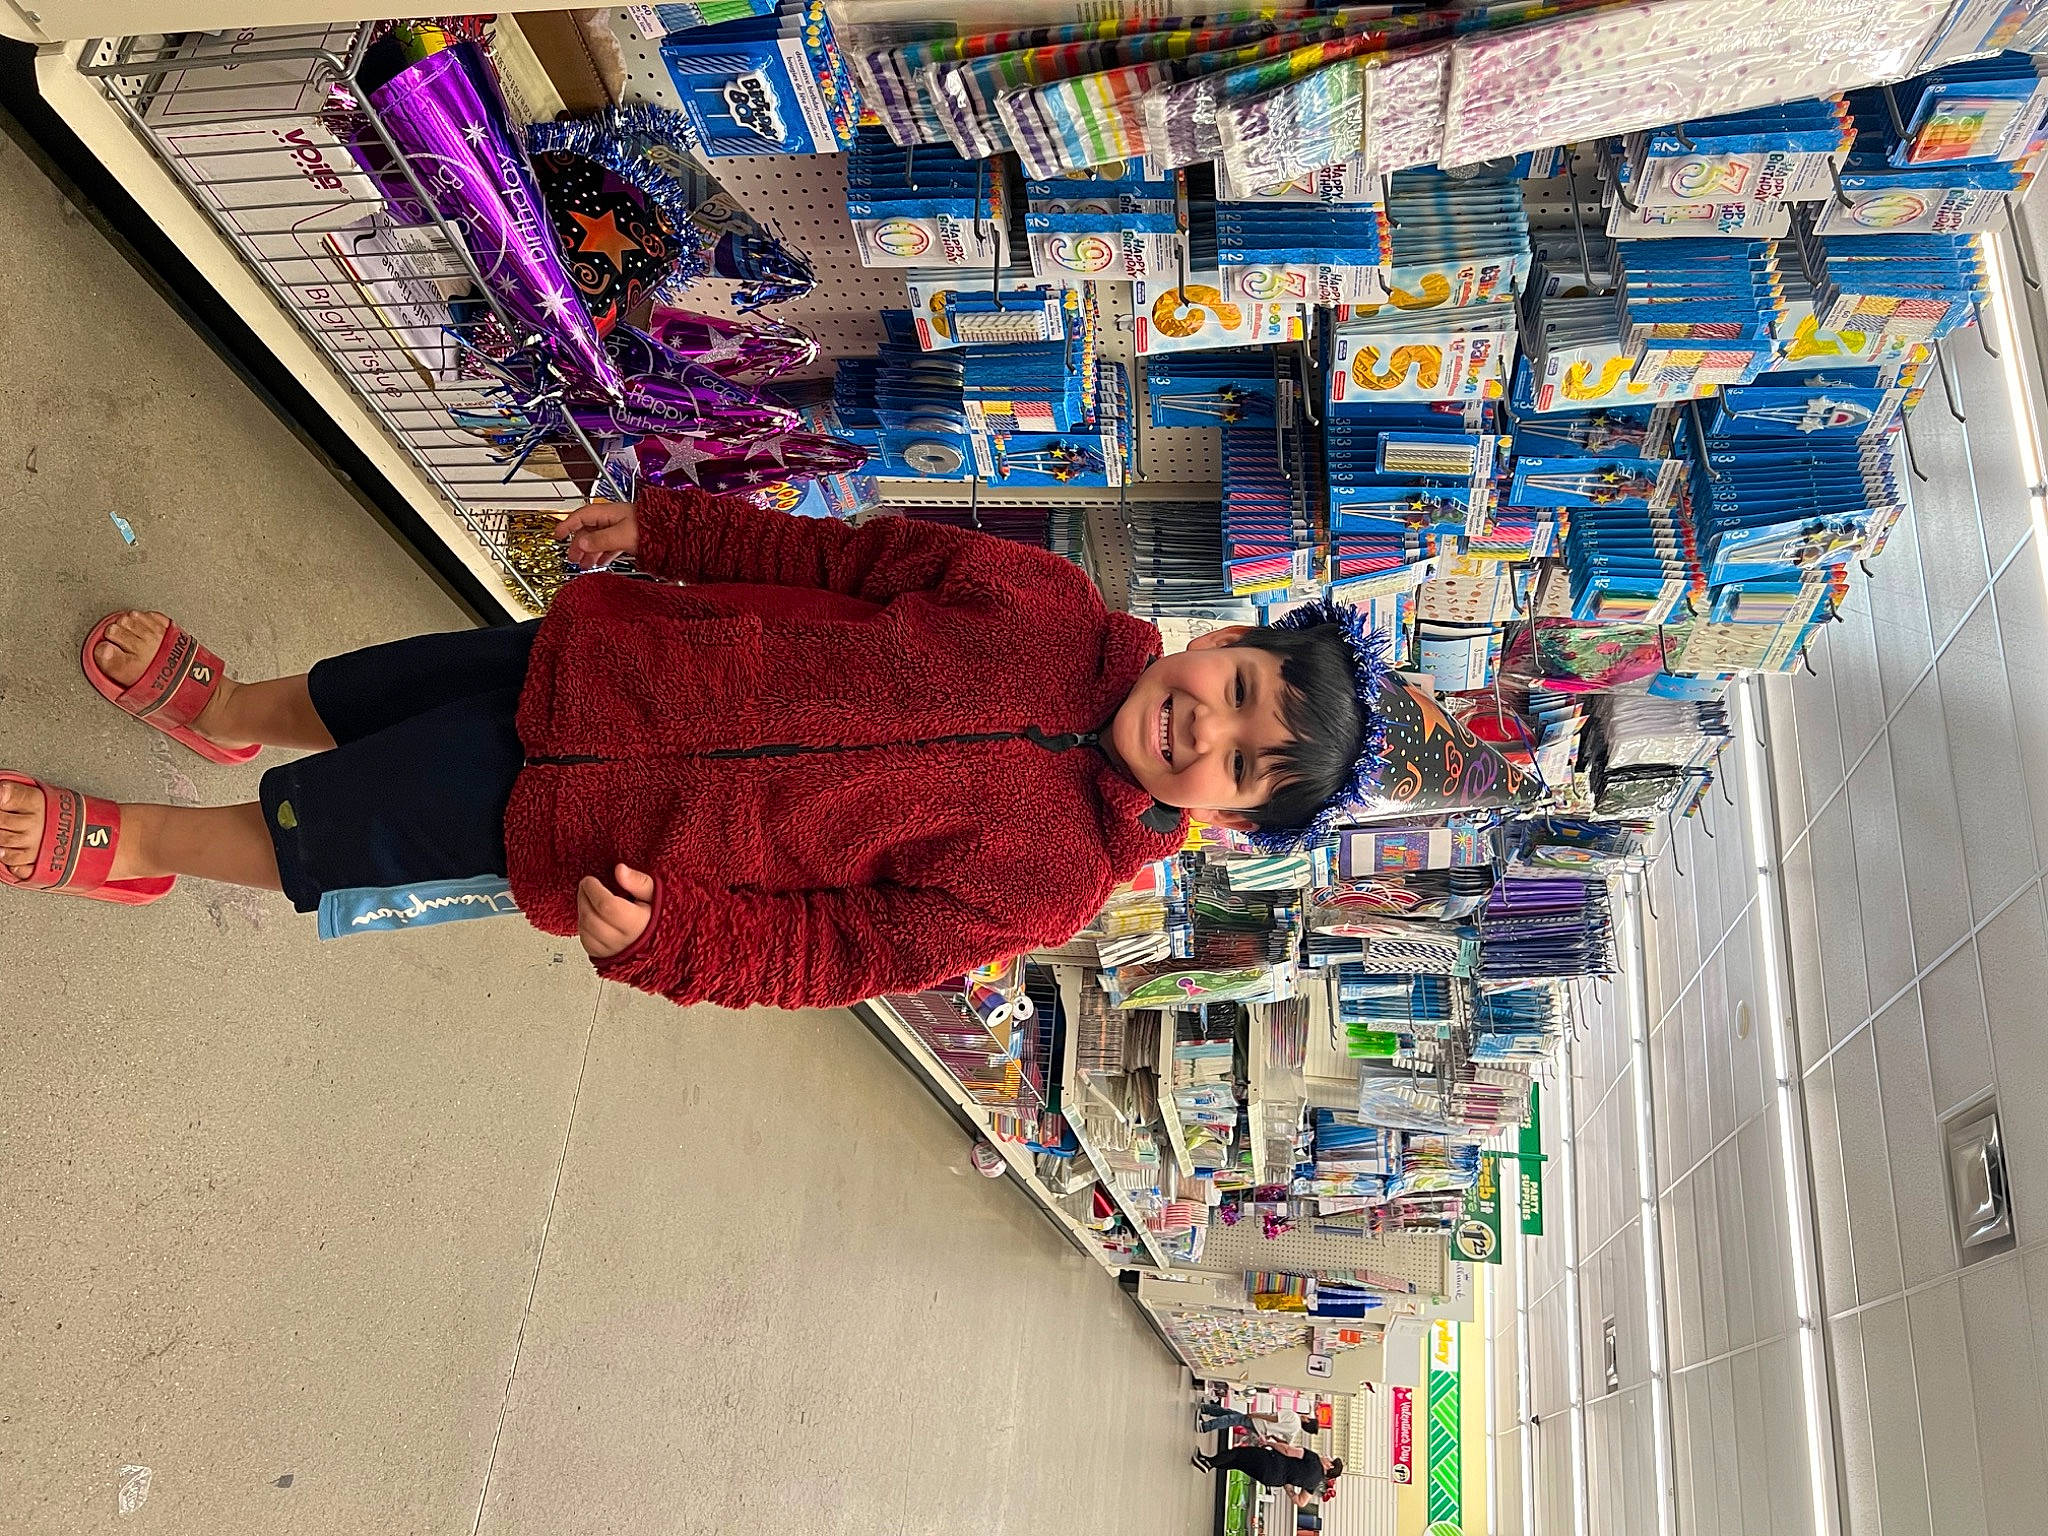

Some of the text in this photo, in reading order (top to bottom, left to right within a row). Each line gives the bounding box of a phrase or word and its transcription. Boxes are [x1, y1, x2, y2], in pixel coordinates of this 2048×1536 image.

[641, 4, 652, 16] 60
[729, 89, 757, 129] BOY
[741, 77, 779, 140] BIRTHDAY
[786, 56, 799, 82] bougies
[796, 83, 803, 91] de
[803, 105, 819, 138] décoratives
[794, 51, 811, 86] decorative
[807, 86, 821, 112] birthday
[816, 112, 827, 131] candle
[1660, 142, 1680, 153] 2
[1035, 185, 1050, 195] 2
[1319, 168, 1333, 204] RTHDAY
[1331, 164, 1347, 200] HAPPY
[1754, 153, 1785, 203] BIRTHDAY
[1771, 160, 1796, 200] HAPPY
[856, 205, 872, 215] 2
[1034, 217, 1050, 228] 2
[1931, 190, 1962, 234] BIRTHDAY
[1950, 197, 1975, 232] HAPPY
[937, 215, 959, 264] BIRTHDAY
[948, 223, 966, 261] HAPPY
[1122, 230, 1137, 279] BIRTHDAY
[1131, 239, 1146, 276] HAPPY
[1227, 253, 1244, 262] 2
[1318, 266, 1332, 306] BIRTHDAY
[1329, 274, 1343, 305] HAPPY
[305, 288, 366, 343] Brght
[1155, 377, 1171, 385] 3
[1463, 338, 1491, 394] balloon
[616, 406, 682, 434] Birthda
[629, 384, 689, 424] Happy
[840, 429, 855, 437] 3
[1717, 455, 1736, 464] 3
[1338, 487, 1355, 495] 3
[1731, 530, 1750, 540] 3
[1598, 578, 1611, 589] 12
[150, 632, 188, 691] SOUTHPOLE
[50, 794, 72, 873] SOUTHPOLE
[1479, 1201, 1495, 1214] it
[1521, 1174, 1531, 1220] SUPPLIES
[1529, 1181, 1539, 1214] PARTY
[1455, 1262, 1466, 1300] allmark
[1434, 1320, 1454, 1365] yday
[1398, 1401, 1412, 1462] Valentine's Day
